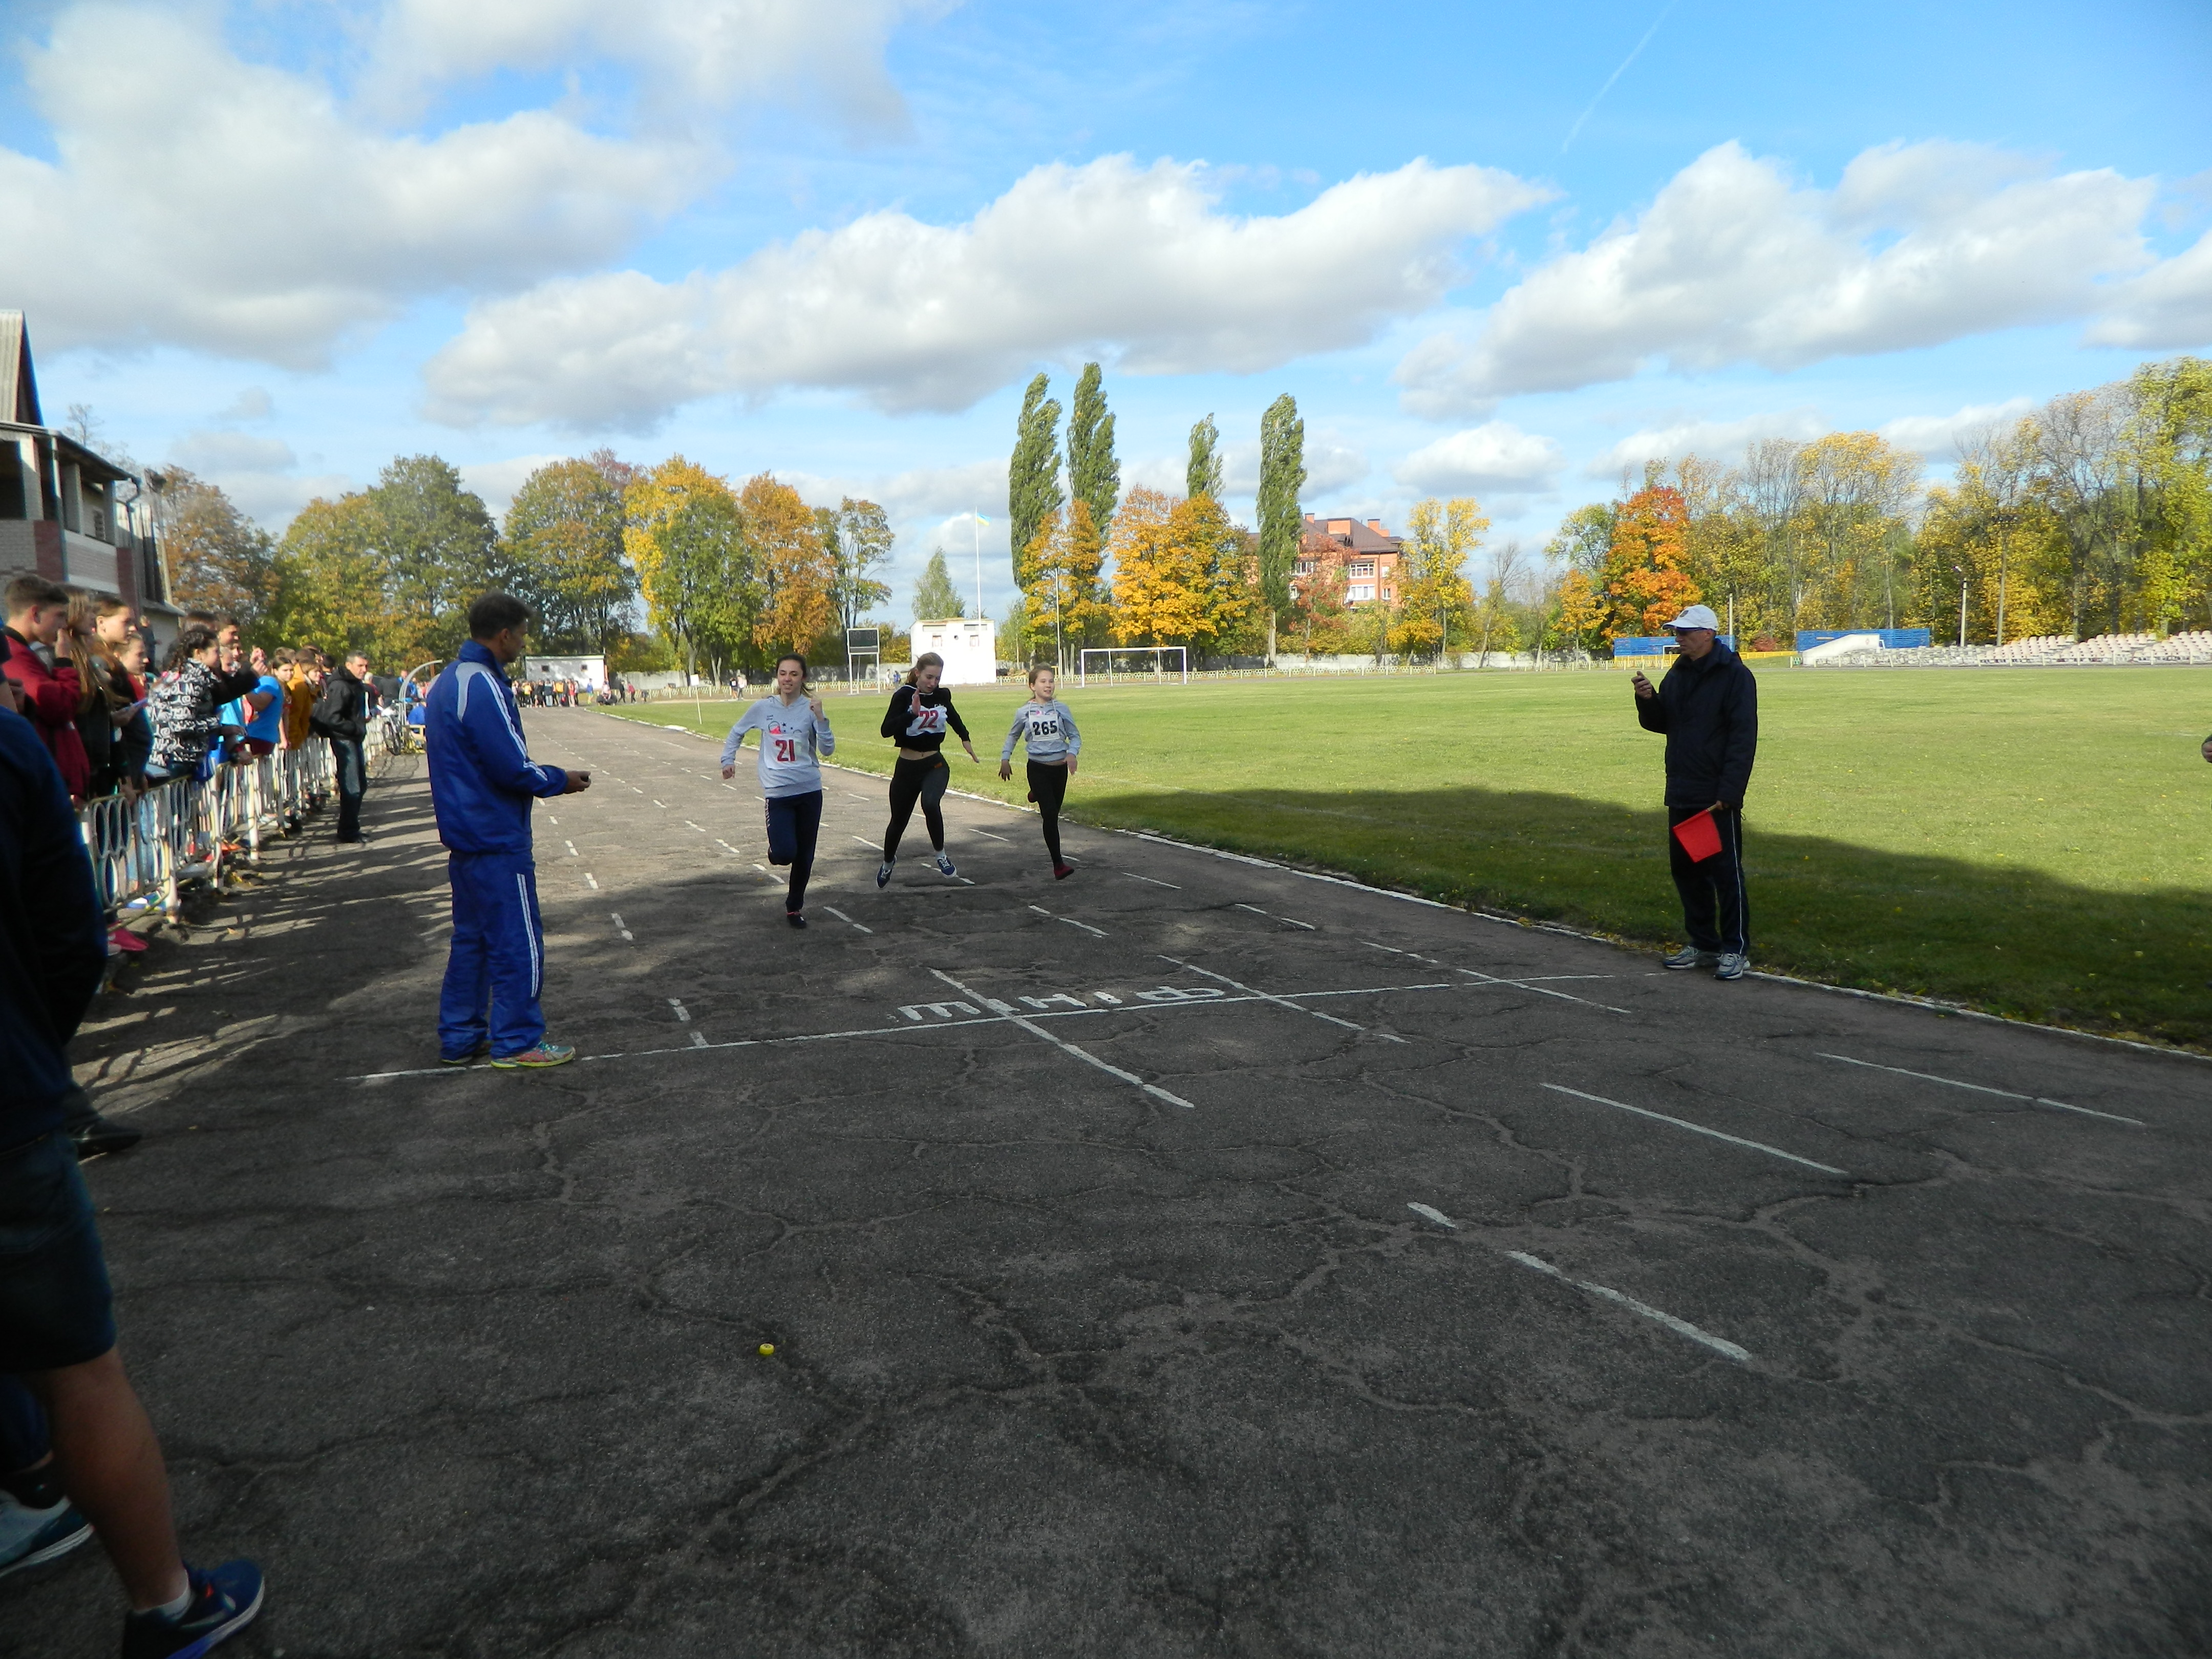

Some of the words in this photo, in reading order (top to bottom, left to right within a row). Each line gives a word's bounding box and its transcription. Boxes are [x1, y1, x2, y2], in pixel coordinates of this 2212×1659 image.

[918, 710, 939, 729] 22
[1032, 720, 1057, 735] 265
[775, 739, 795, 762] 21
